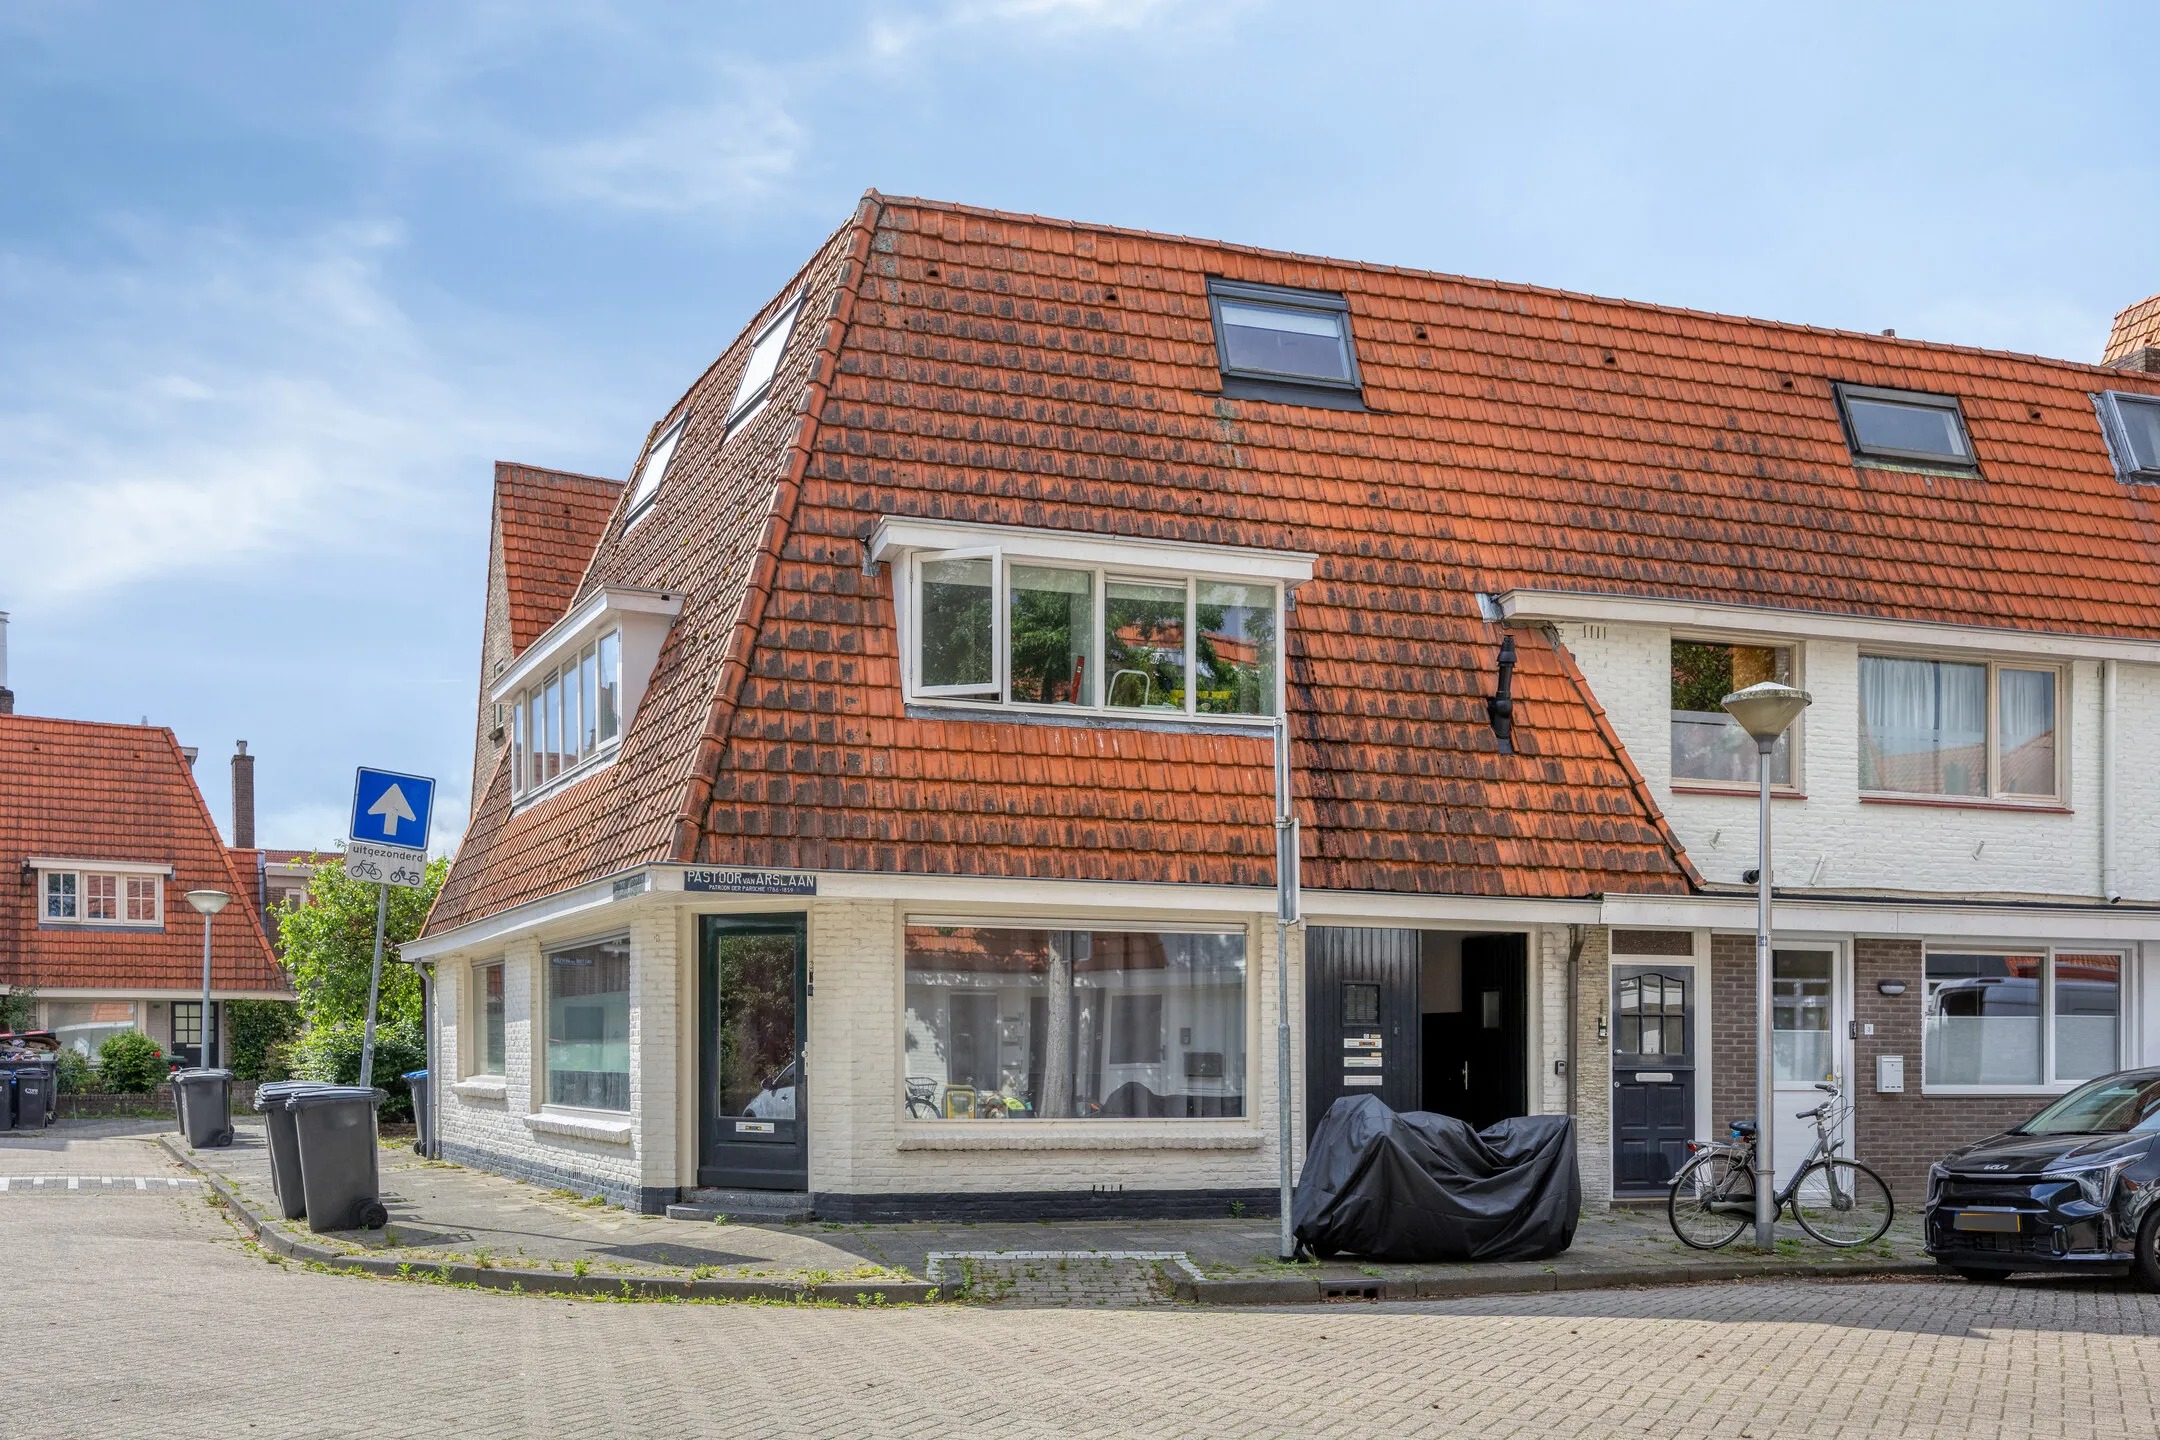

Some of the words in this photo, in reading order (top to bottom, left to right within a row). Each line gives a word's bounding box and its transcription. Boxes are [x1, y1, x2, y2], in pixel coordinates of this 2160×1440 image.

[352, 845, 424, 863] uitgezonderd
[687, 870, 742, 885] PASTOOR
[756, 873, 814, 888] ARSLAAN
[708, 884, 731, 892] PATROON
